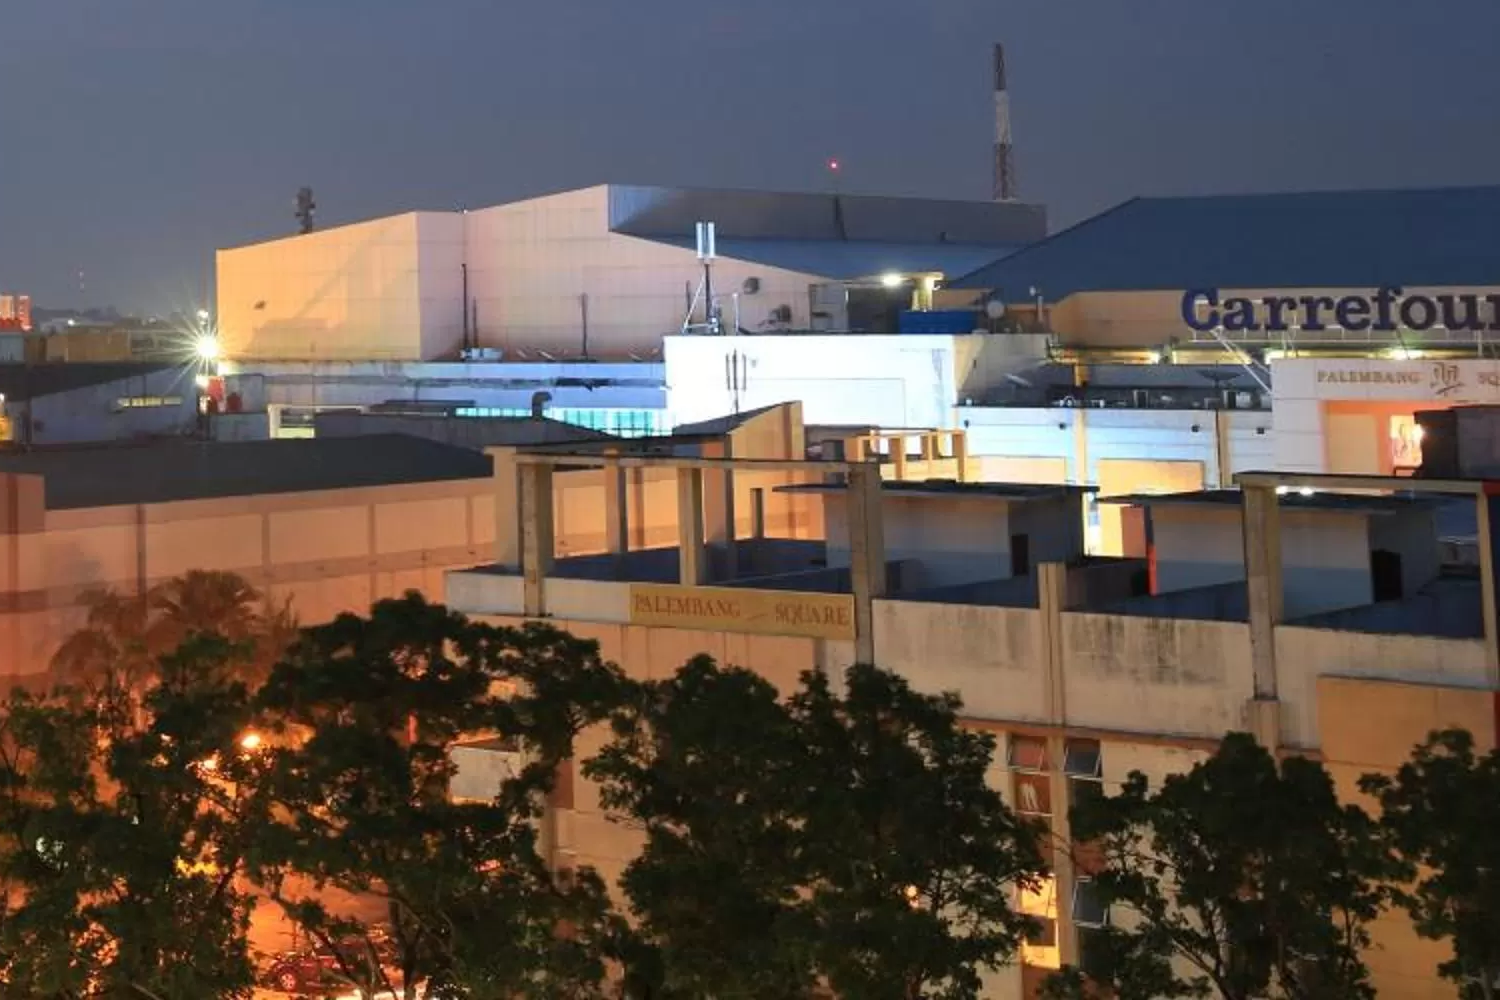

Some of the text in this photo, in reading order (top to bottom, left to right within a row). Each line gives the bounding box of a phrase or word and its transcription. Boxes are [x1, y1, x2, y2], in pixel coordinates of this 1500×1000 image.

[1316, 370, 1422, 385] PALEMBANG
[634, 593, 850, 626] PALEMBANG SQUARE
